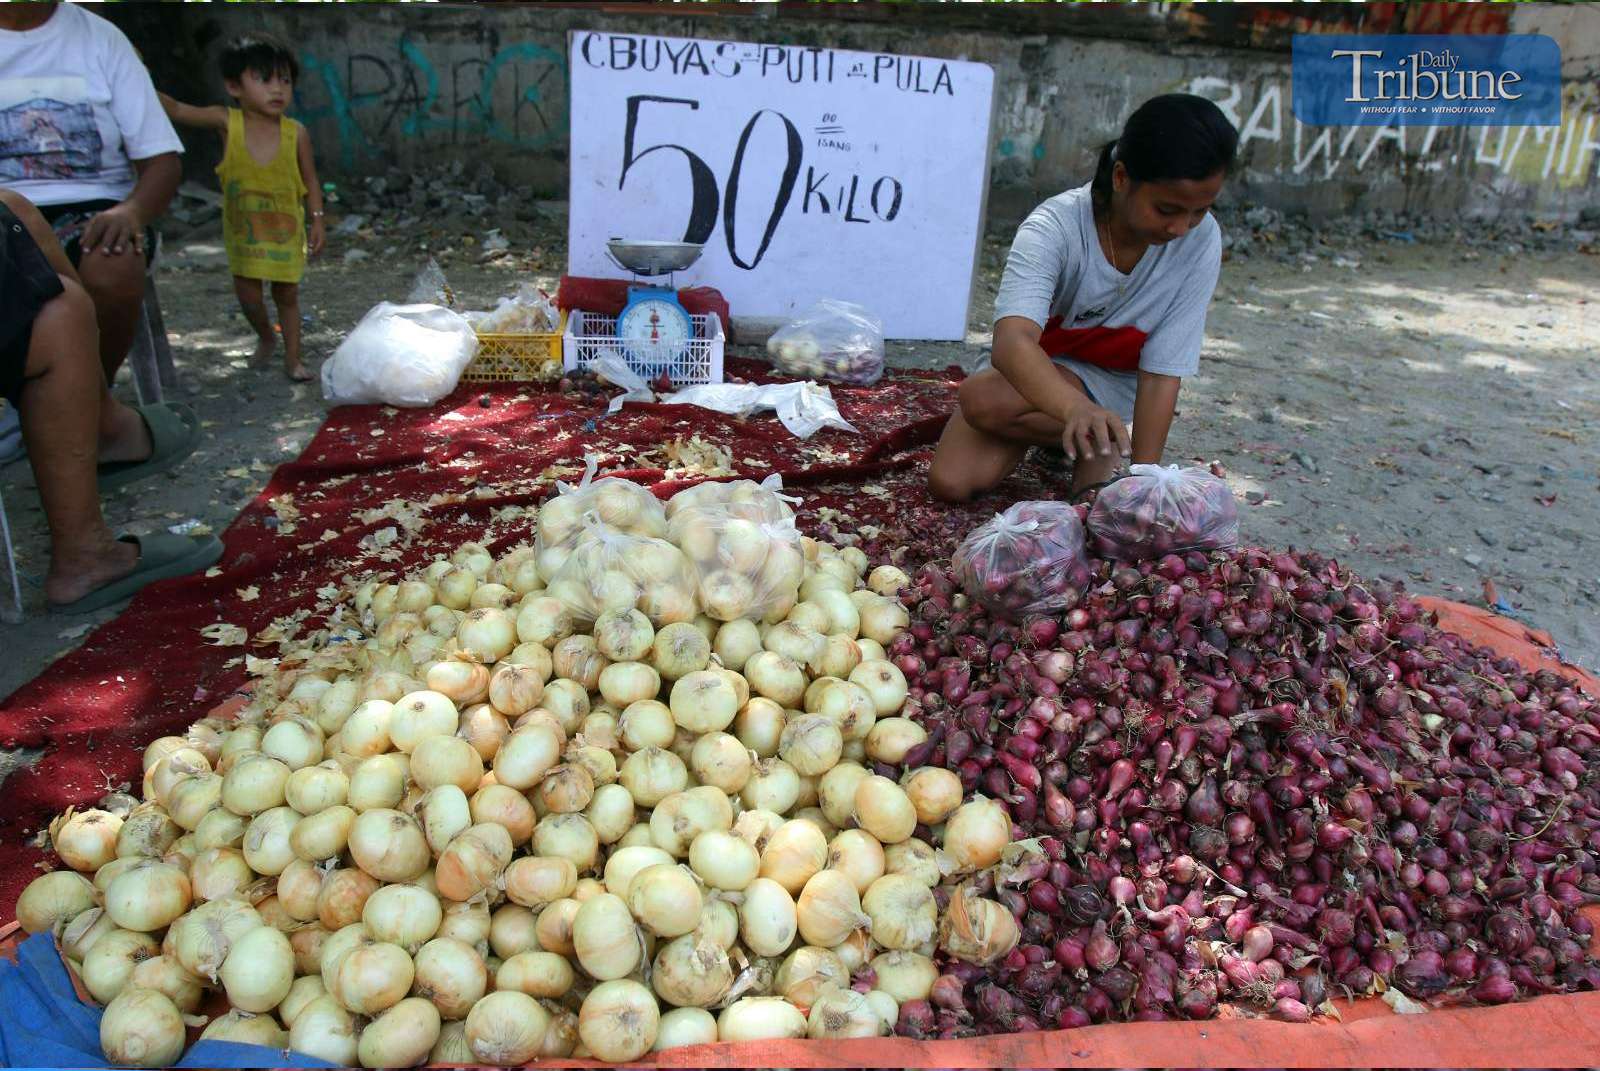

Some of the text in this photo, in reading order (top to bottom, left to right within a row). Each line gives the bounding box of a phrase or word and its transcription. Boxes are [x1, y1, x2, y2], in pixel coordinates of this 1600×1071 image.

[761, 46, 834, 84] PUTI
[873, 55, 954, 96] PULA
[619, 94, 804, 271] 50
[802, 165, 903, 224] KILO
